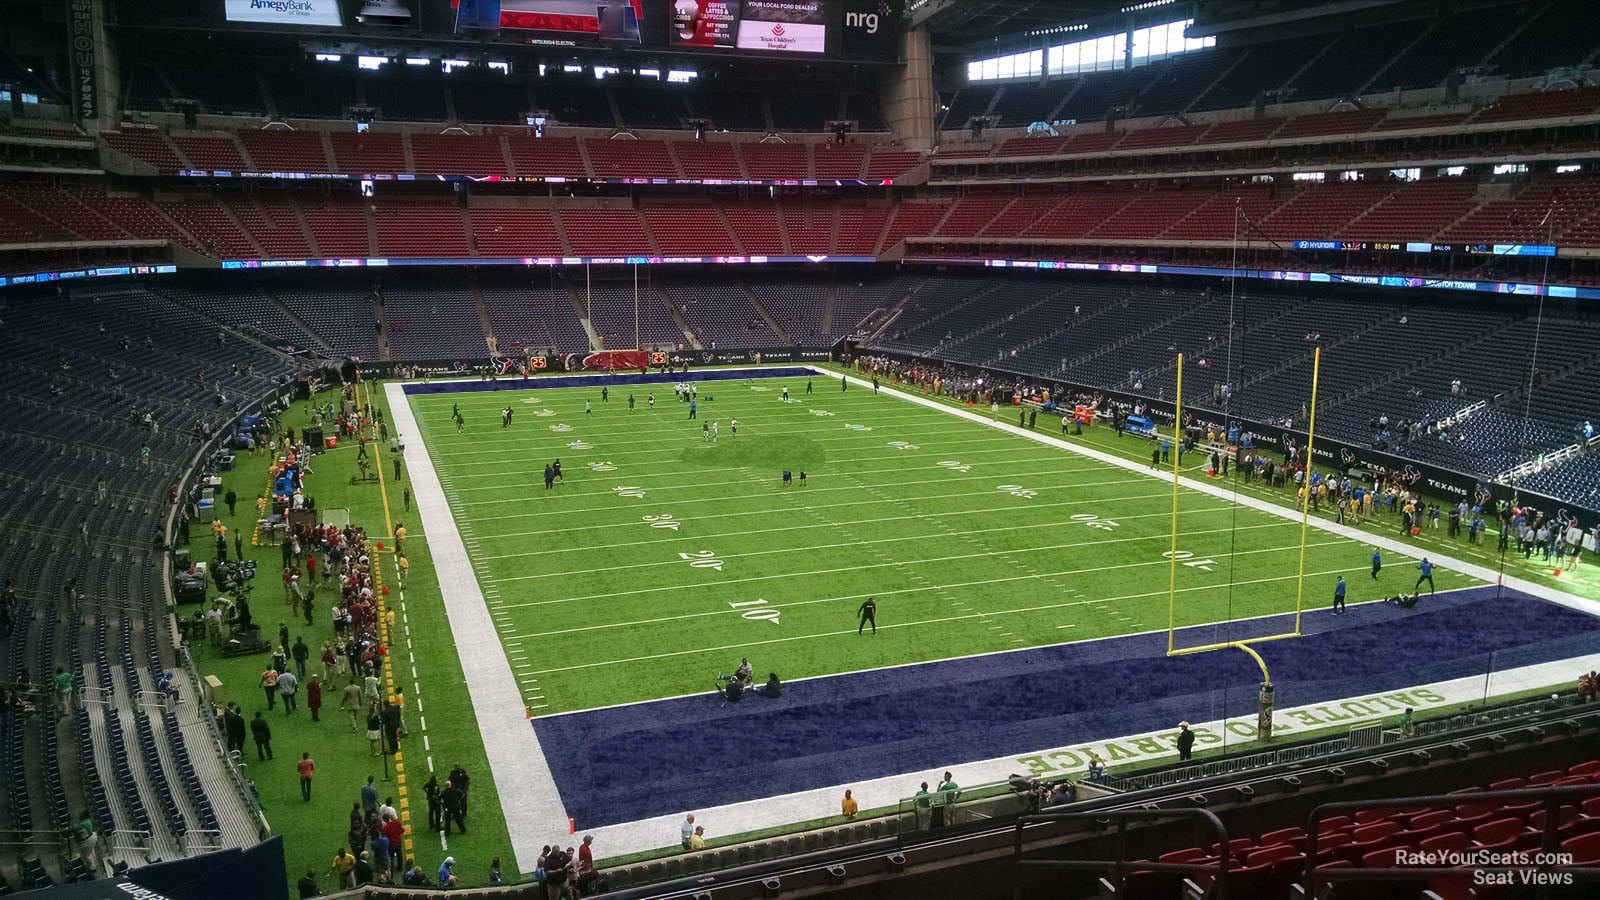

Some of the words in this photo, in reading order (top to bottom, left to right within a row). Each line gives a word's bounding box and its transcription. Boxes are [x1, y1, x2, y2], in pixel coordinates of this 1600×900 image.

[250, 0, 313, 12] AmegyBank
[846, 12, 879, 34] nrg
[1309, 241, 1335, 249] HYUNDAI
[1454, 281, 1477, 291] TEXANS
[1361, 461, 1386, 473] TEXA
[1427, 478, 1468, 497] TEXANS
[679, 549, 725, 571] 20
[728, 598, 782, 625] 10
[1287, 688, 1445, 727] SALUTE
